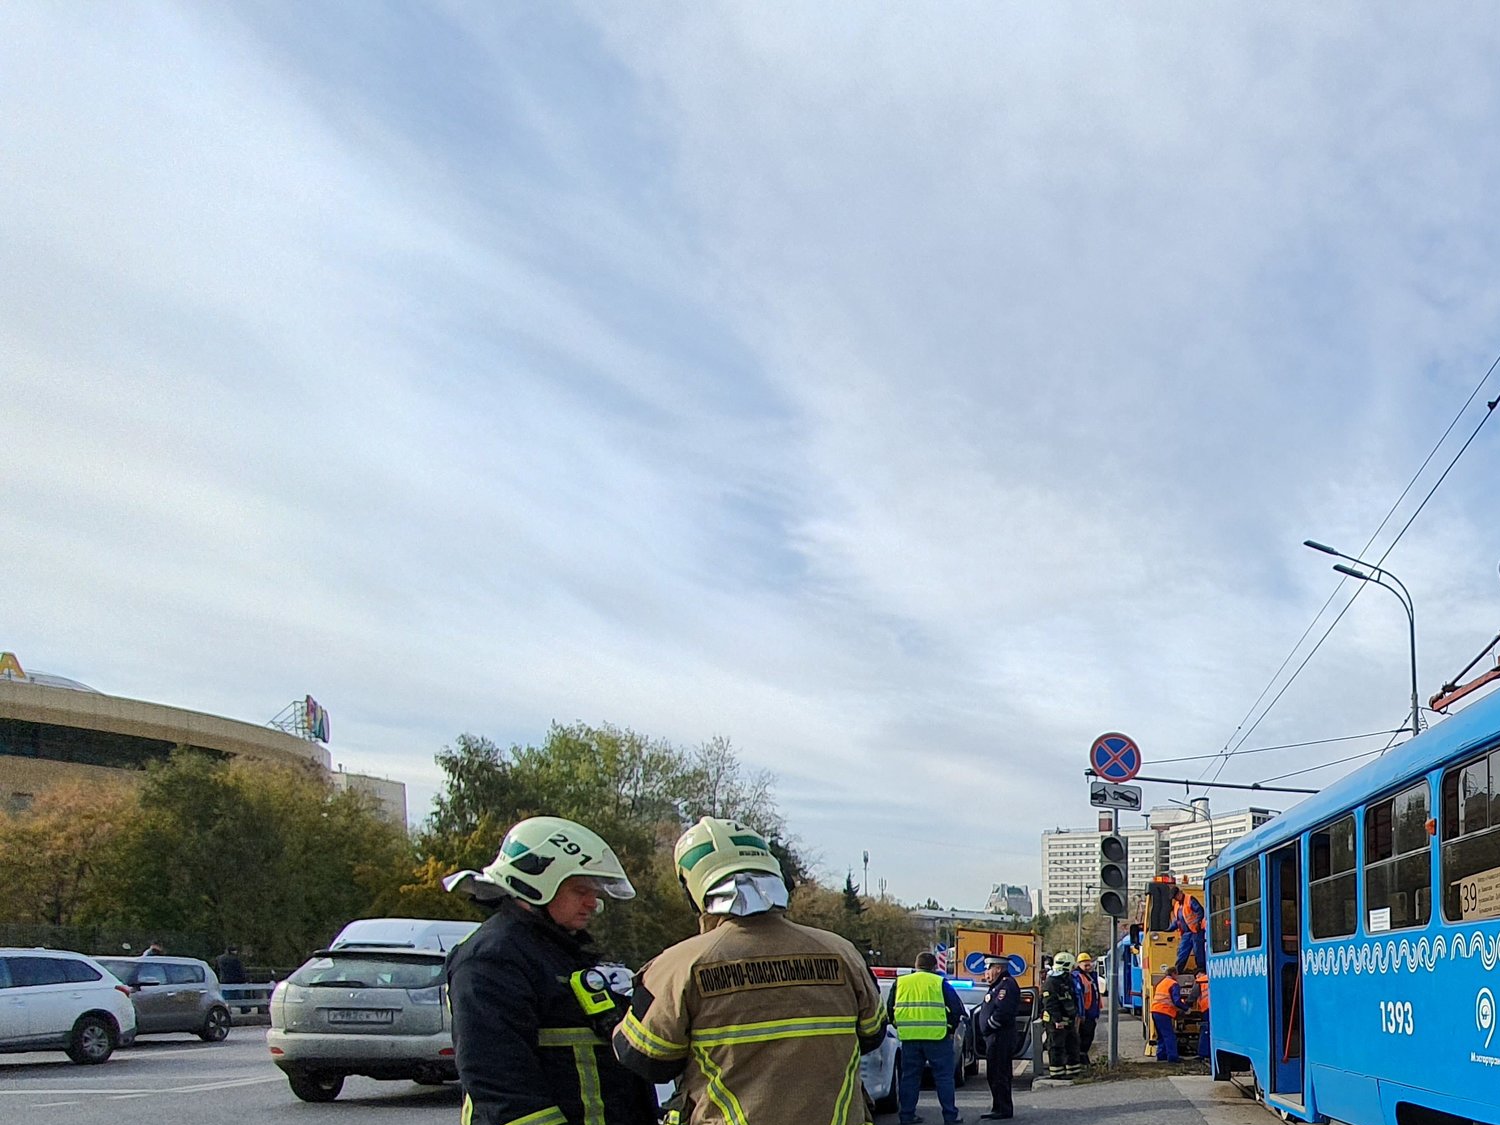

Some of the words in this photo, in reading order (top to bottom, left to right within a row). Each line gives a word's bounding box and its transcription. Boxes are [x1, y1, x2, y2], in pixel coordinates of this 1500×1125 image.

[548, 834, 593, 867] 291
[1462, 882, 1478, 913] 39
[699, 957, 815, 992] ПОЖАРНО-СПАСАТЕЛЬНЫЙ
[815, 958, 840, 981] ЦЕНТР
[1379, 1001, 1415, 1035] 1393
